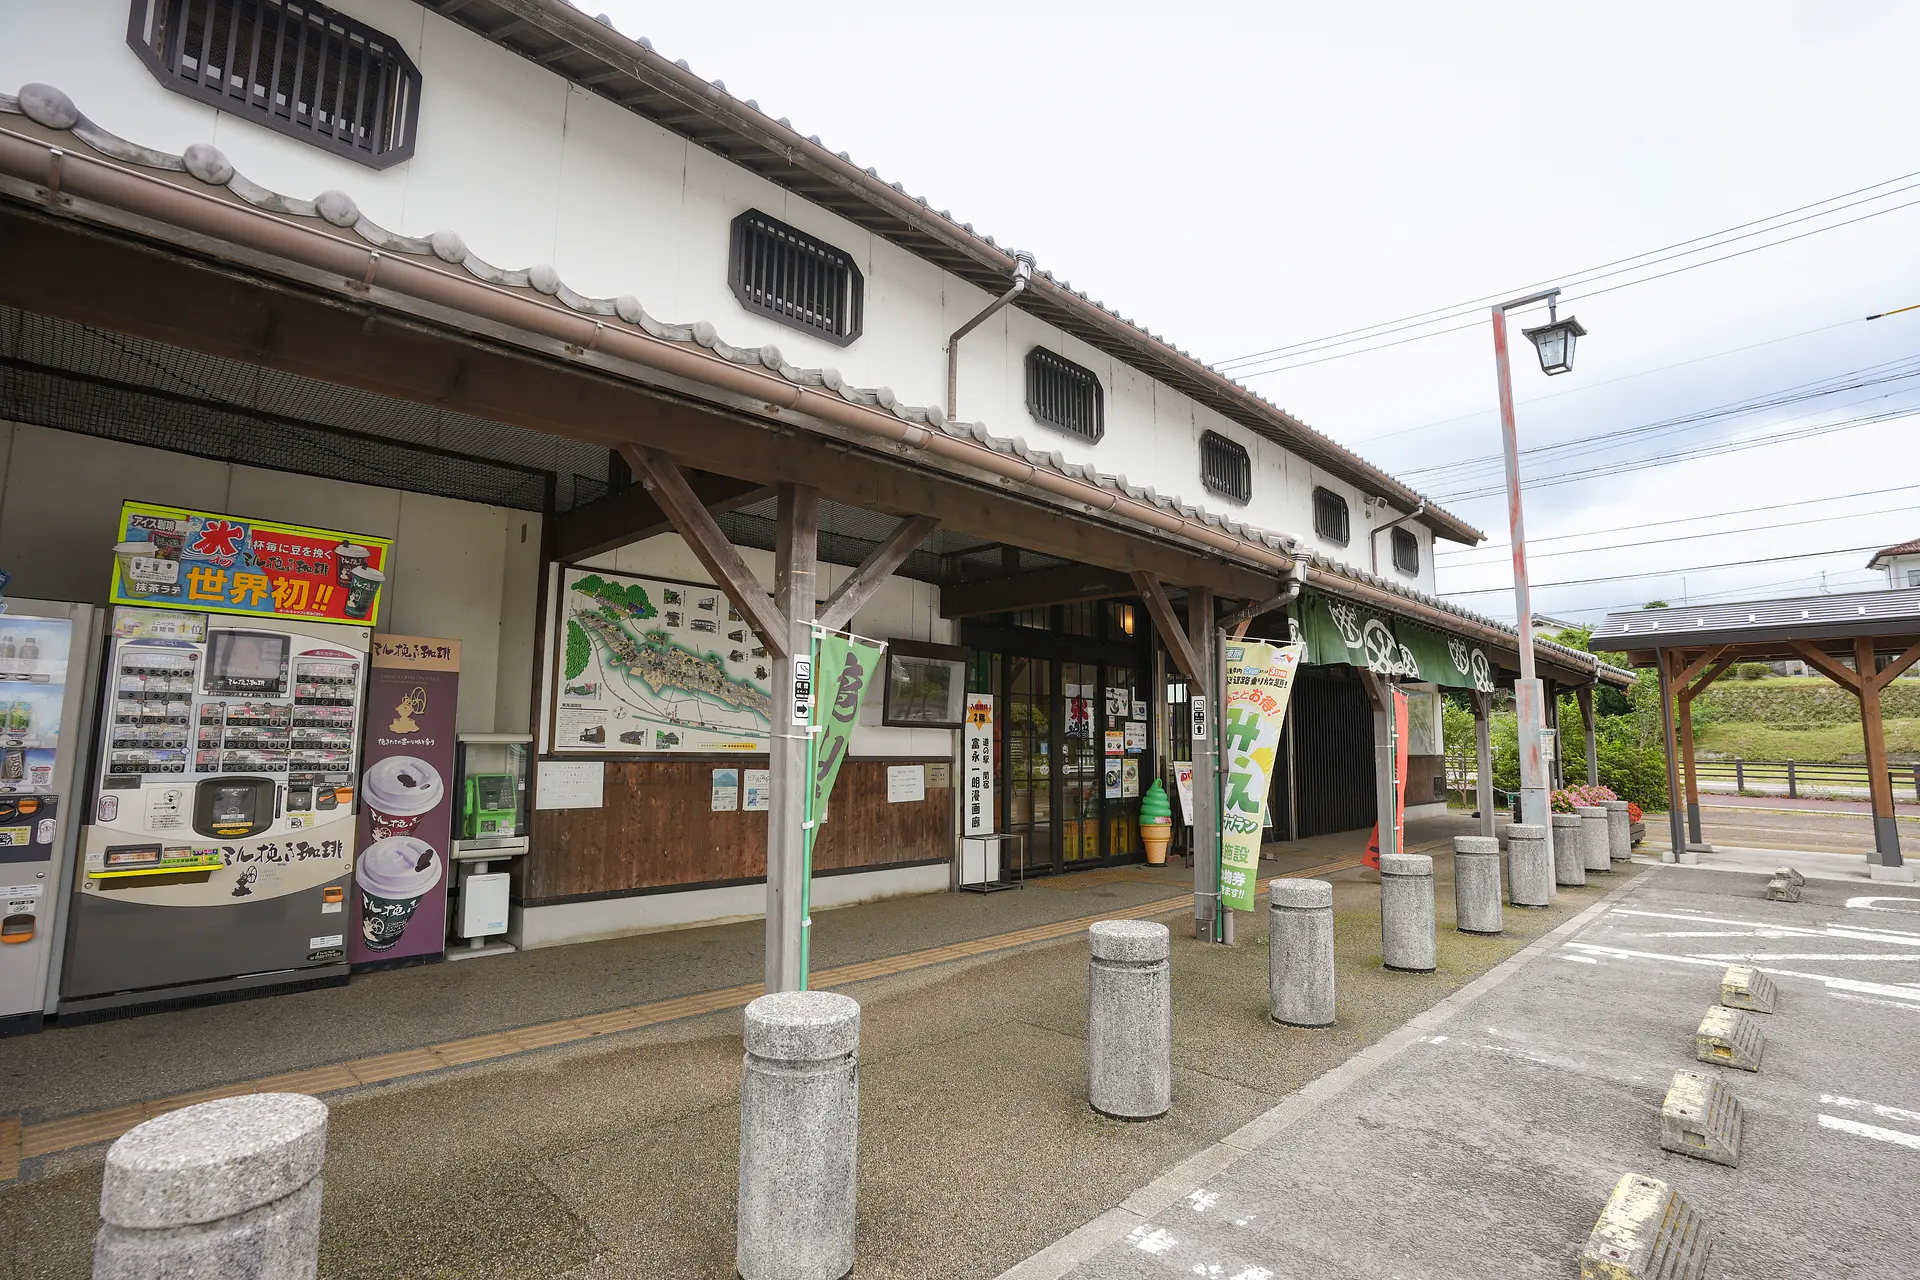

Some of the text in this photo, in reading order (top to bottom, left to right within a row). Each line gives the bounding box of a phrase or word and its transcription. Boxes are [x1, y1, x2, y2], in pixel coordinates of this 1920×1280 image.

[193, 520, 244, 556] 氷
[373, 642, 451, 661] ミル挽き珈琲
[11, 754, 22, 777] BOSS
[222, 839, 343, 866] ミル挽き珈琲
